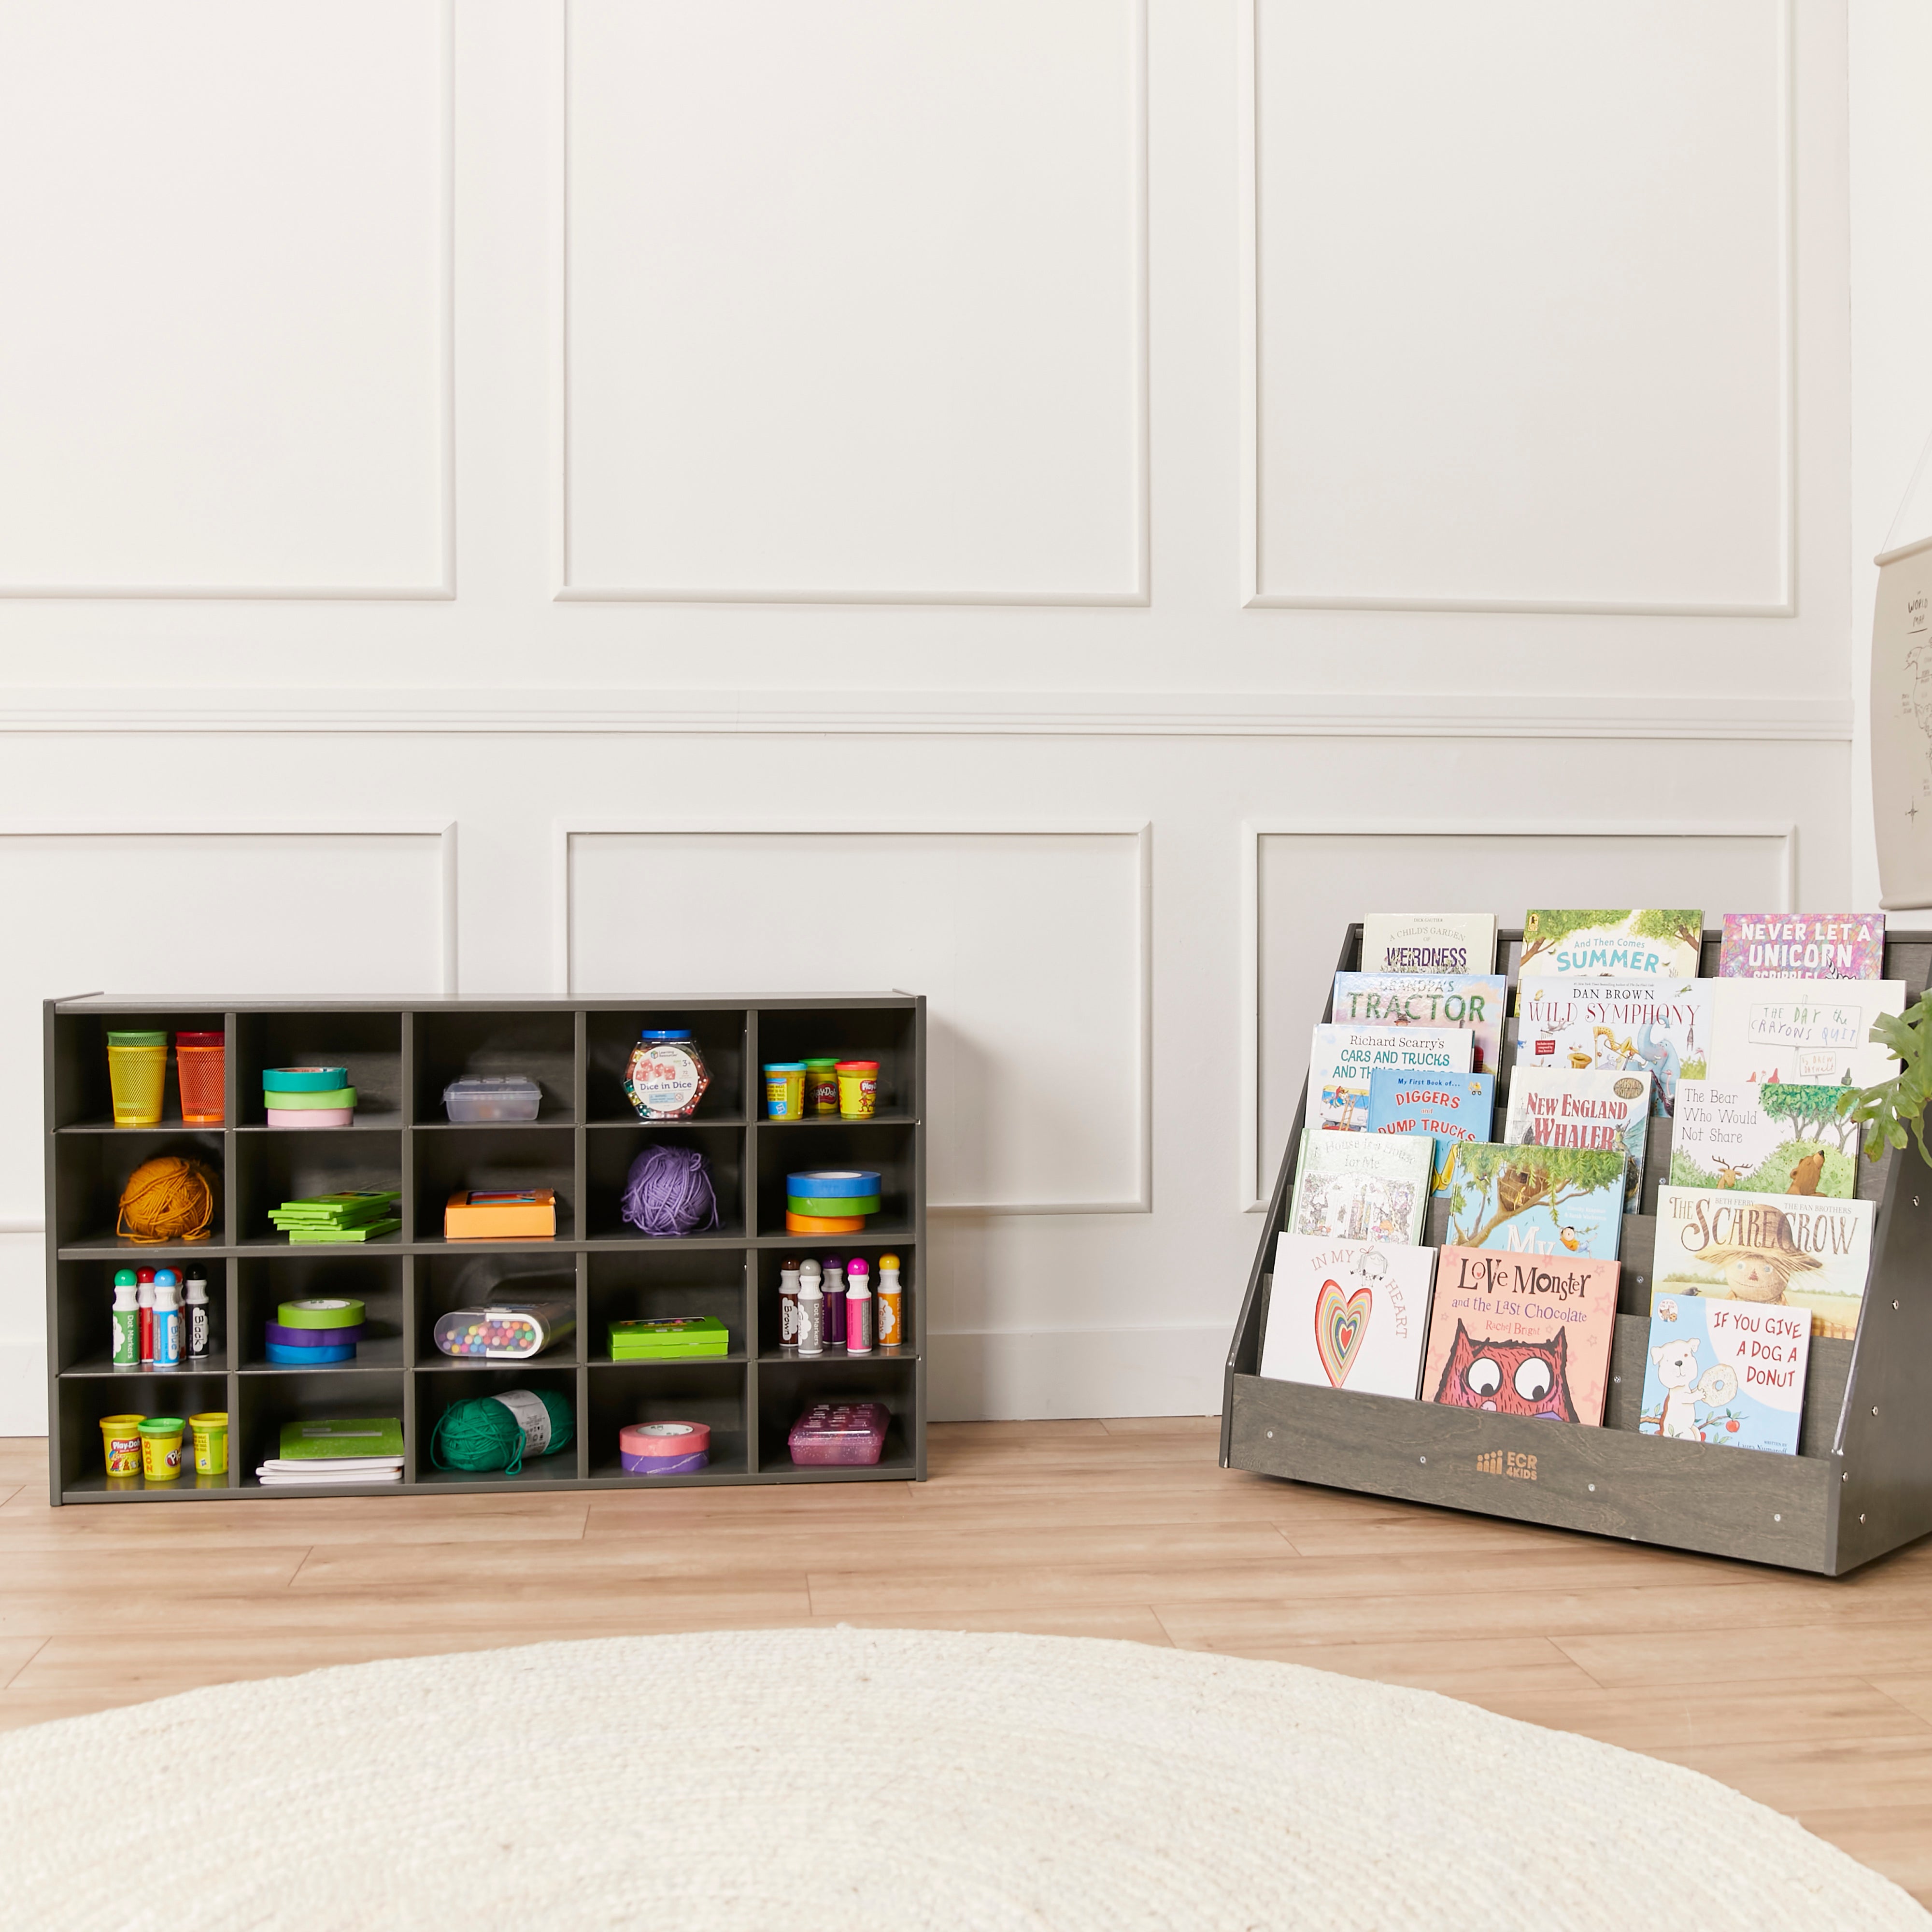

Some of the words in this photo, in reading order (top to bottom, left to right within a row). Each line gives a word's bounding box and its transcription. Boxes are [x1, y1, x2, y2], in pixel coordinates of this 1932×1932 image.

[1397, 927, 1428, 940] CHILD'S
[1430, 927, 1466, 942] GARDEN
[1741, 923, 1806, 941] NEVER
[1815, 923, 1852, 940] LET
[1857, 924, 1871, 941] A
[1574, 938, 1591, 949] And
[1594, 938, 1614, 946] Then
[1617, 938, 1645, 949] Comes
[1386, 947, 1467, 966] WEIRDNESS
[1556, 949, 1659, 973] SUMMER
[1748, 943, 1853, 968] UNICORN
[1573, 989, 1599, 999] DAN
[1606, 990, 1655, 1000] BROWN
[1347, 992, 1486, 1022] TRACTOR
[1529, 1001, 1578, 1022] WILD
[1585, 1002, 1701, 1025] SYMPHONY
[1763, 1008, 1784, 1019] THE
[1794, 1007, 1821, 1024] DAY
[1833, 1009, 1847, 1025] the
[1751, 1019, 1812, 1040] CRAYONS
[1821, 1026, 1856, 1045] QUIT
[1350, 1035, 1396, 1047] Richard
[1398, 1037, 1445, 1051] Scarry's
[1341, 1049, 1371, 1062] CARS
[1373, 1051, 1398, 1064] AND
[1402, 1052, 1450, 1066] TRUCKS
[1332, 1065, 1357, 1078] AND
[1395, 1090, 1461, 1109] DIGGERS
[1525, 1092, 1559, 1116] NEW
[1561, 1094, 1627, 1120] ENGLAND
[1685, 1088, 1705, 1102] The
[1710, 1090, 1738, 1104] Bear
[1683, 1107, 1712, 1122] Who
[1718, 1109, 1757, 1124] Would
[1378, 1119, 1416, 1135] DUMP
[1421, 1119, 1476, 1142] TRUCKS
[1534, 1118, 1615, 1151] WHALER
[1682, 1127, 1704, 1141] Not
[1709, 1128, 1743, 1143] Share
[1669, 1197, 1694, 1220] THE
[1815, 1206, 1852, 1214] BROTHERS
[1681, 1197, 1859, 1255] SCARECROW
[1311, 1253, 1327, 1271] IN
[1331, 1250, 1355, 1264] MY
[1512, 1265, 1591, 1301] Monster
[1385, 1278, 1407, 1339] HEART
[1451, 1298, 1470, 1308] and
[1473, 1297, 1491, 1312] the
[1495, 1300, 1521, 1315] Last
[1524, 1303, 1588, 1323] Chocolate
[194, 1316, 204, 1346] Black
[784, 1306, 792, 1335] Brown
[1486, 1320, 1511, 1334] Rachel
[1513, 1322, 1540, 1336] Bright
[1714, 1311, 1729, 1328] IF
[1734, 1314, 1760, 1333] YOU
[1765, 1318, 1802, 1339] GIVE
[1736, 1341, 1746, 1356] A
[1751, 1341, 1782, 1362] DOG
[1787, 1347, 1797, 1363] A
[1747, 1365, 1795, 1387] DONUT
[113, 1440, 141, 1449] Play-Doh
[1507, 1451, 1538, 1470] ECR
[1506, 1466, 1537, 1480] 4KIDS
